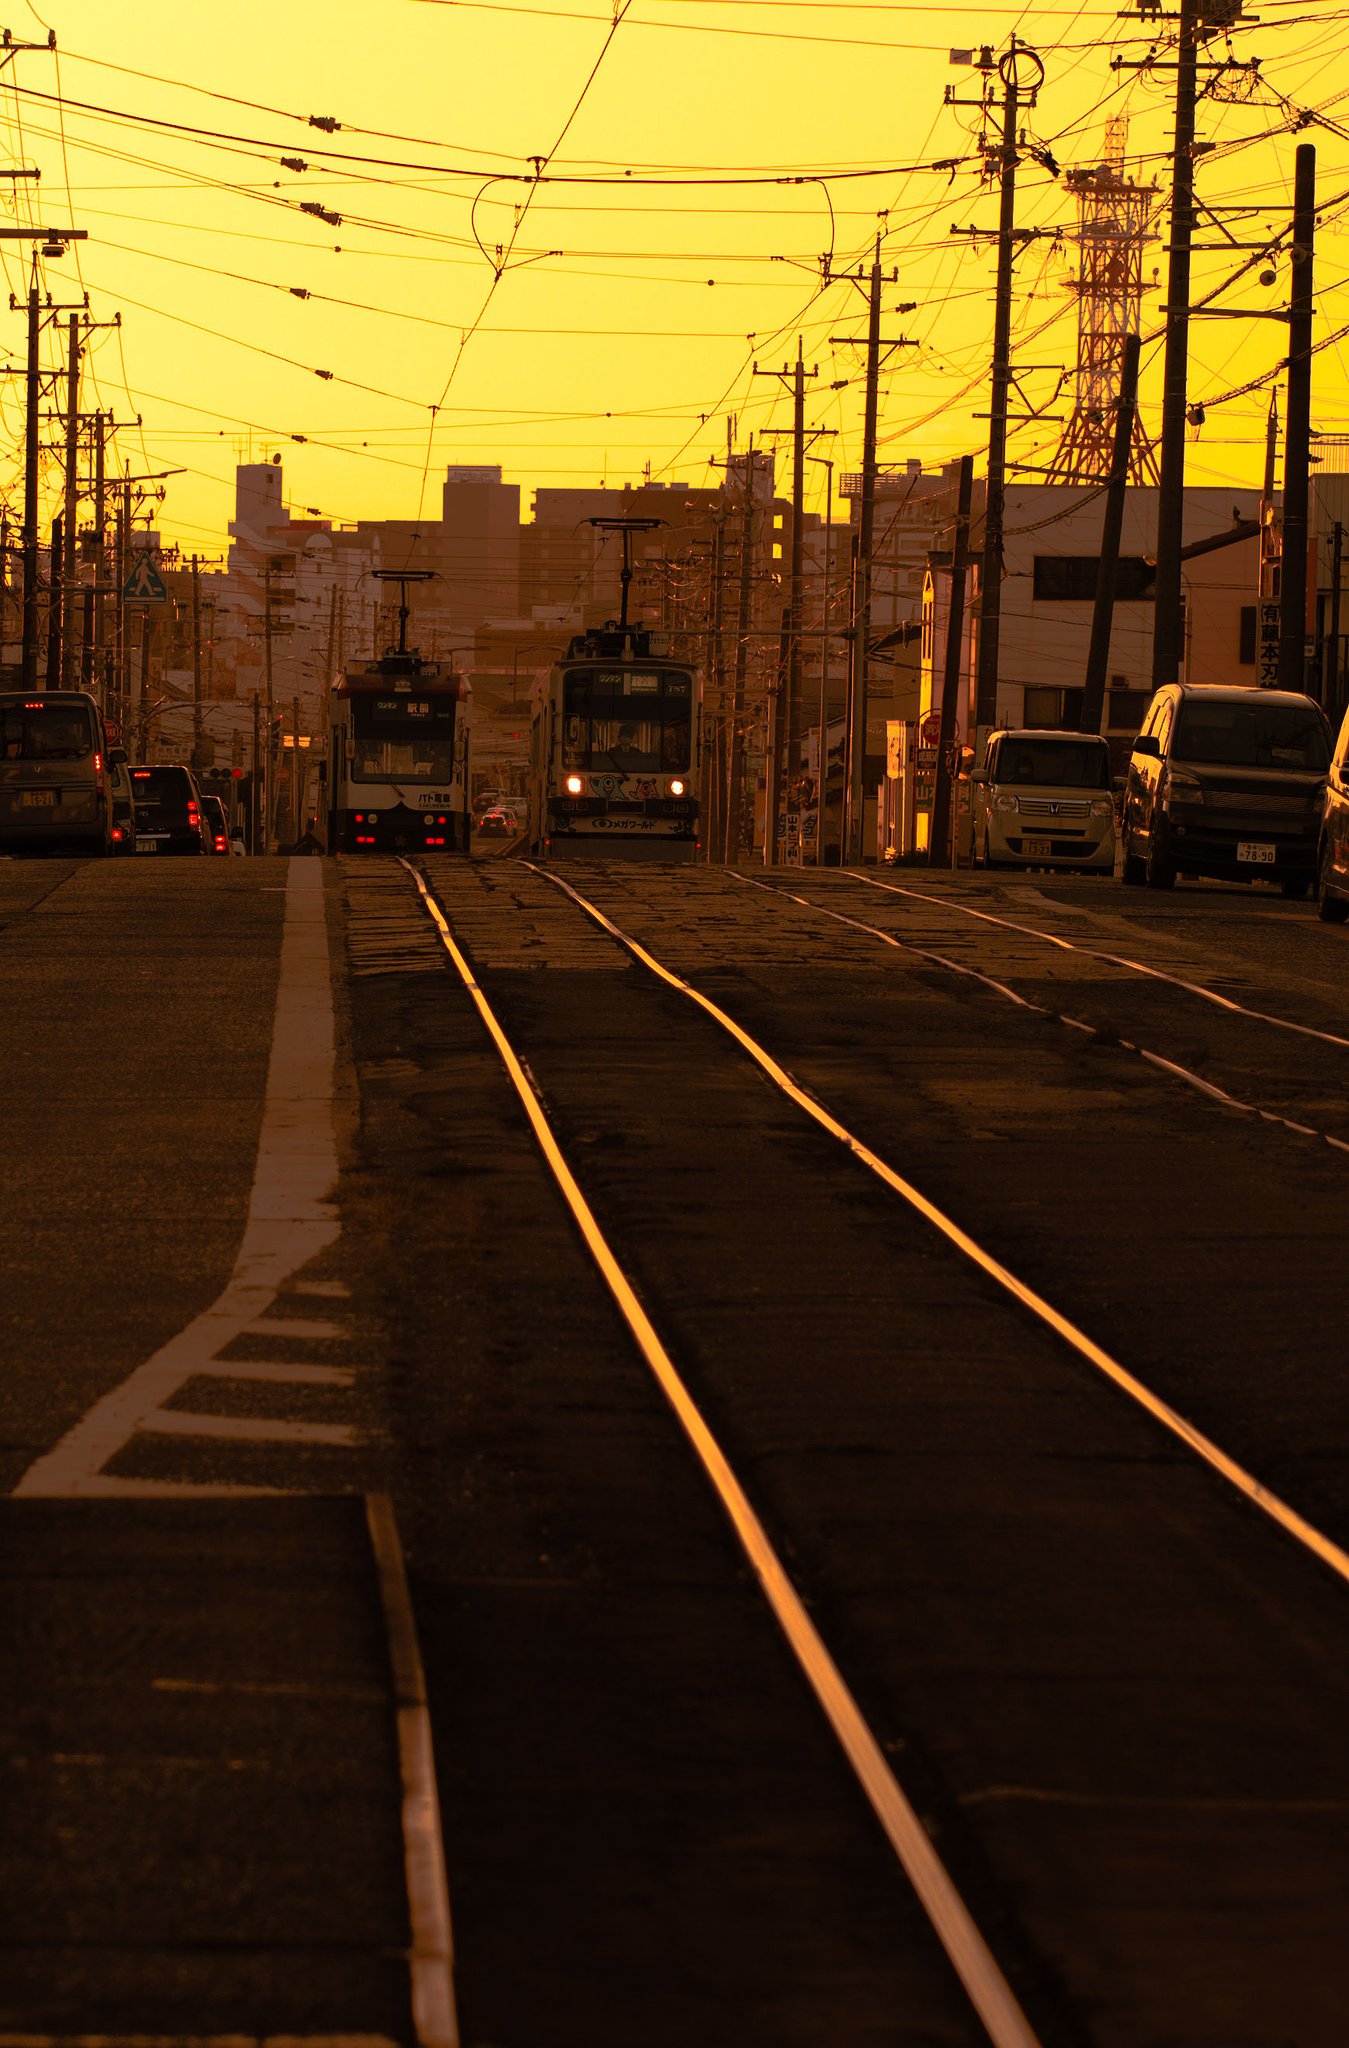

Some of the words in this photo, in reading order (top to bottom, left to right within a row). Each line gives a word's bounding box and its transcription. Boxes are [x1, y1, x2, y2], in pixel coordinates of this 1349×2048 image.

[614, 819, 657, 829] メガワールド
[1245, 850, 1273, 861] 78-90
